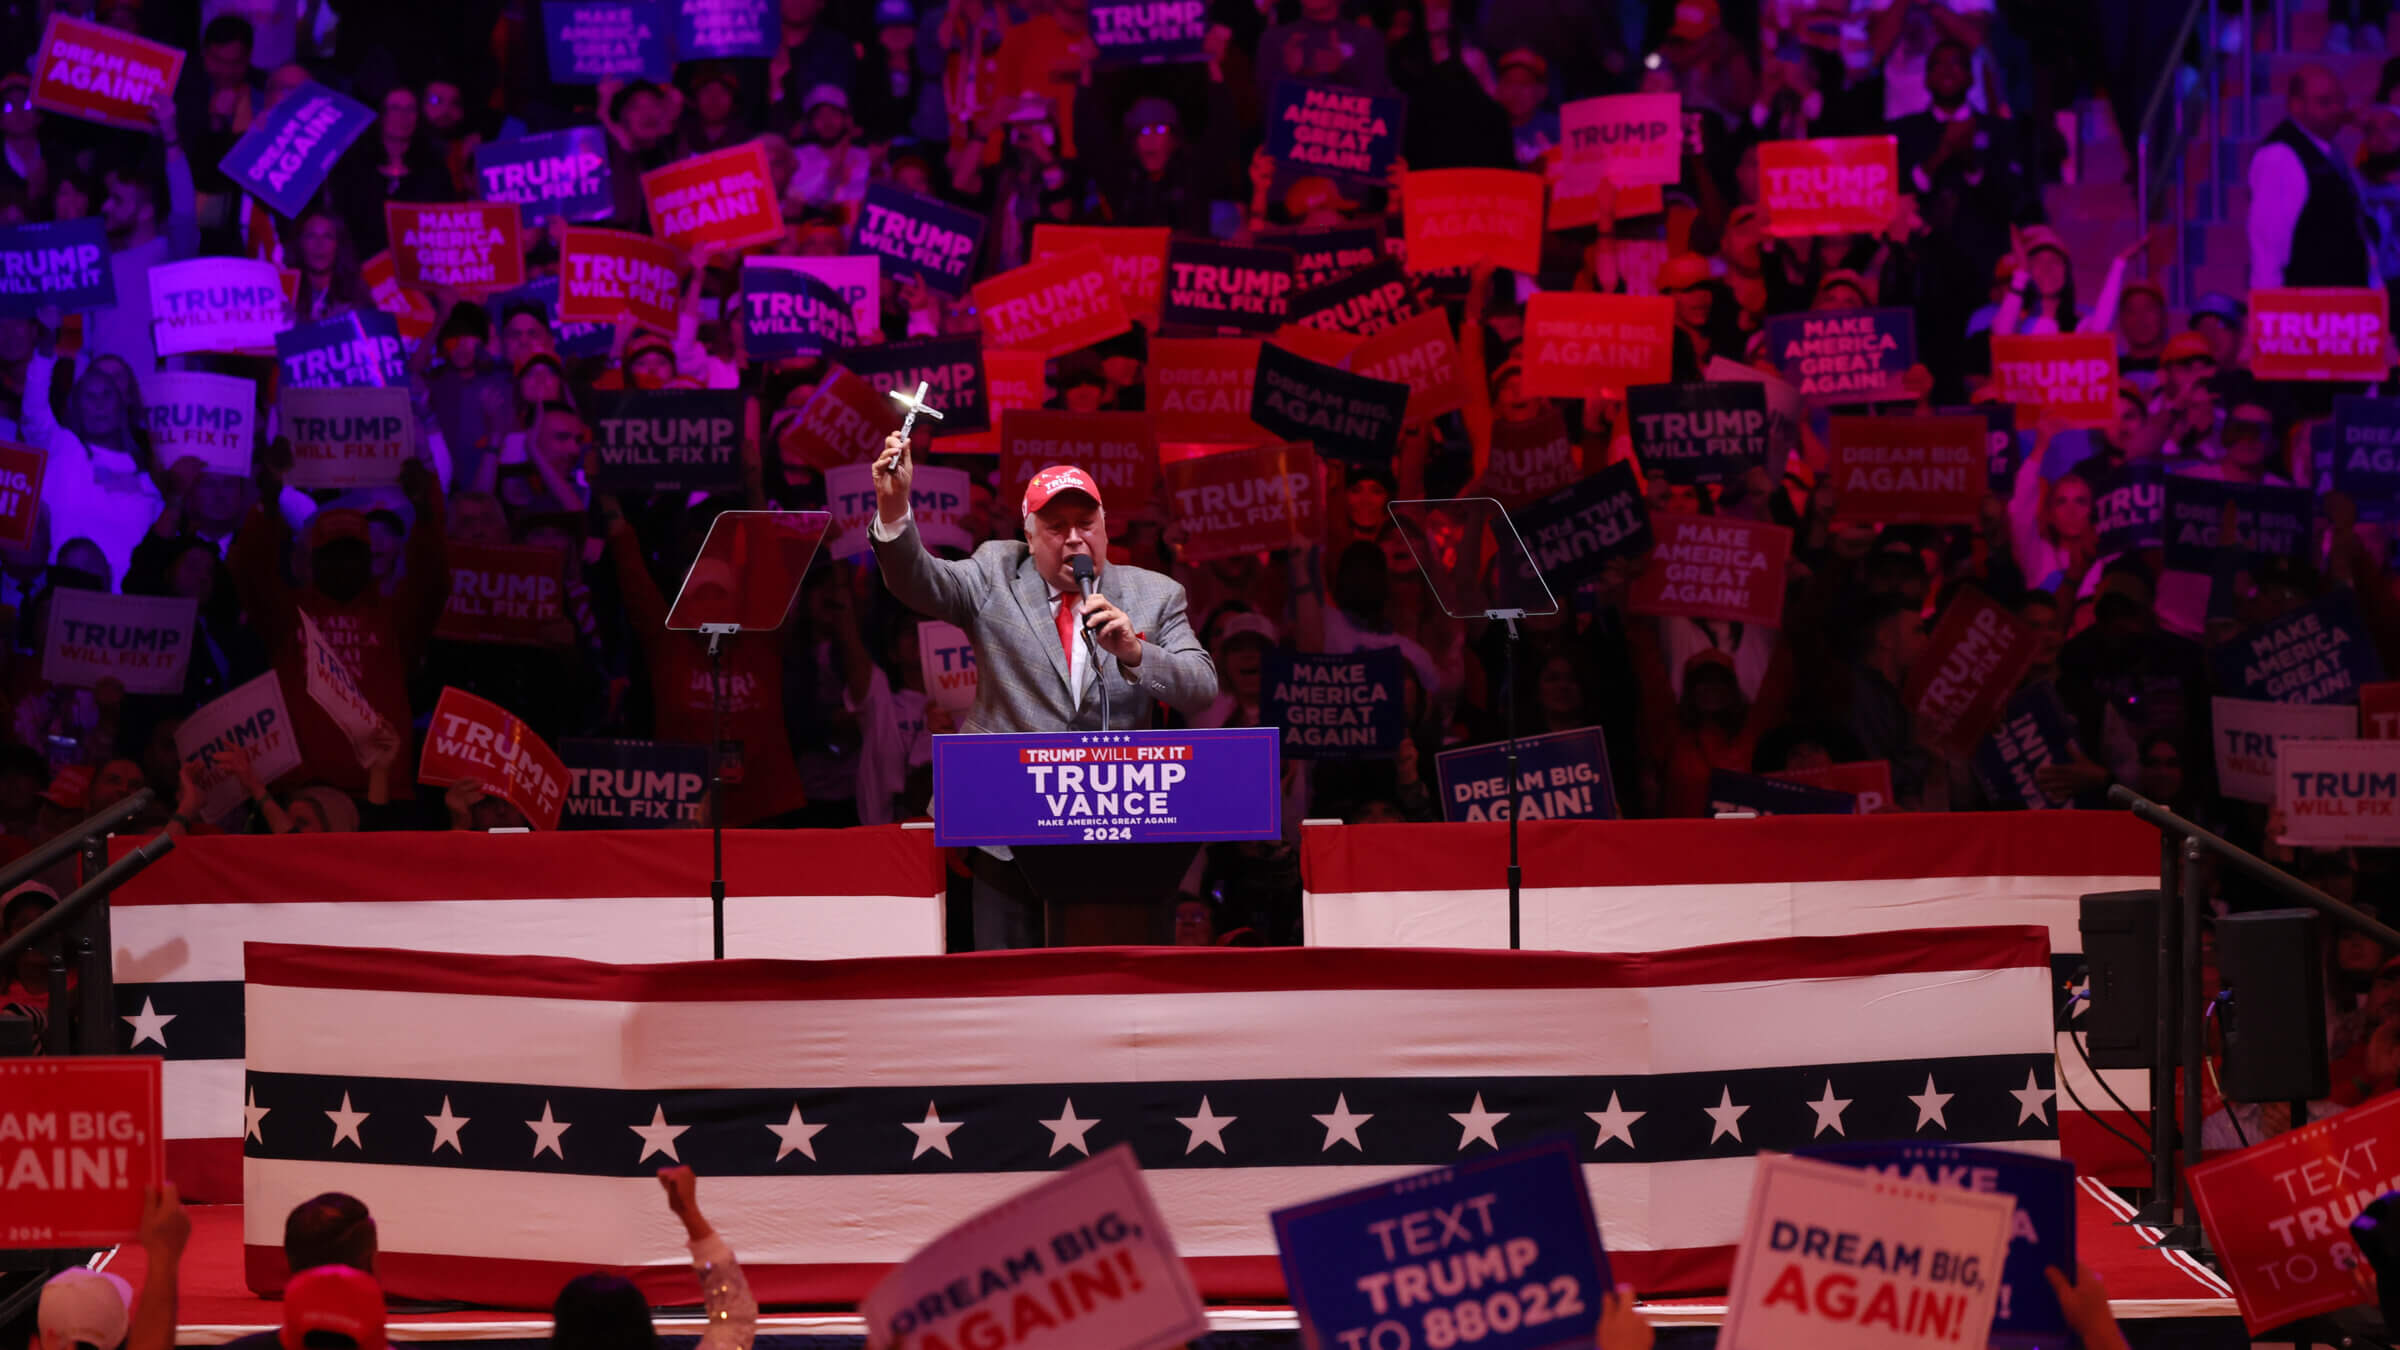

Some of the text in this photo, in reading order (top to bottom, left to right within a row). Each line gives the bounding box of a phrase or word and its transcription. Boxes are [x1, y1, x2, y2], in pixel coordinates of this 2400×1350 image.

[1092, 1, 1204, 31] TRUMP
[52, 39, 125, 70] DREAM
[47, 60, 155, 107] AGAIN!
[1304, 88, 1373, 116] MAKE
[1284, 104, 1388, 137] AMERICA
[268, 104, 344, 193] AGAIN!
[1293, 124, 1372, 153] GREAT
[1570, 121, 1667, 150] TRUMP
[247, 119, 298, 181] DREAM
[482, 154, 603, 192] TRUMP
[1766, 165, 1889, 194] TRUMP
[541, 180, 575, 200] FIX
[577, 176, 601, 195] IT
[416, 211, 484, 229] MAKE
[663, 191, 760, 237] AGAIN!
[403, 228, 505, 247] AMERICA
[865, 204, 973, 258] TRUMP
[415, 246, 494, 268] GREAT
[860, 229, 967, 277] WILL FIX IT
[41, 272, 79, 294] FIX
[81, 268, 101, 288] IT
[417, 264, 497, 286] AGAIN!
[567, 253, 679, 293] TRUMP
[1171, 262, 1292, 298] TRUMP
[163, 286, 276, 310] TRUMP
[568, 279, 658, 307] WILL FIX
[984, 272, 1106, 326] TRUMP
[1171, 290, 1288, 316] WILL FIX IT
[167, 309, 212, 328] WILL
[745, 292, 854, 334] TRUMP
[748, 318, 804, 336] WILL
[1803, 316, 1876, 336] MAKE
[2256, 311, 2382, 338] TRUMP
[997, 317, 1048, 345] WILL
[284, 335, 405, 381] TRUMP
[1538, 341, 1652, 368] AGAIN!
[1784, 332, 1897, 360] AMERICA
[2259, 336, 2381, 357] WILL FIX IT
[383, 357, 405, 379] IT
[1801, 353, 1882, 376] GREAT
[1999, 359, 2110, 386] TRUMP
[1265, 369, 1391, 423] DREAM BIG,
[1801, 371, 1887, 396] AGAIN!
[2047, 384, 2108, 403] FIX IT
[953, 389, 975, 409] IT
[144, 404, 244, 430] TRUMP
[1265, 391, 1380, 440] AGAIN!
[1636, 408, 1764, 443] TRUMP
[182, 430, 240, 449] FIX IT
[292, 416, 403, 444] TRUMP
[600, 418, 735, 446] TRUMP
[292, 441, 403, 460] WILL FIX IT
[600, 444, 735, 466] WILL FIX IT
[1013, 439, 1145, 463] DREAM BIG,
[1640, 435, 1766, 459] WILL FIX IT
[1841, 446, 1925, 466] DREAM
[1043, 476, 1084, 490] TRUMP
[1174, 472, 1310, 517] TRUMP
[1846, 467, 1966, 494] AGAIN!
[1180, 497, 1313, 536] WILL FIX IT
[1676, 521, 1753, 549] MAKE
[1652, 542, 1769, 572] AMERICA
[1664, 563, 1753, 588] GREAT
[1658, 582, 1752, 609] AGAIN!
[491, 599, 559, 621] FIX IT
[63, 619, 181, 652] TRUMP
[2251, 611, 2323, 660] MAKE
[60, 643, 179, 671] WILL FIX IT
[2243, 626, 2352, 687] AMERICA
[1292, 662, 1367, 685] MAKE
[2265, 649, 2342, 698] GREAT
[1273, 683, 1389, 705] AMERICA
[1285, 704, 1375, 726] GREAT
[264, 730, 281, 752] IT
[1283, 726, 1378, 747] AGAIN!
[443, 711, 560, 799] TRUMP
[1027, 747, 1186, 763] TRUMP WILL FIX IT
[436, 736, 554, 815] WILL FIX IT
[567, 767, 703, 801] TRUMP
[1026, 763, 1186, 794] TRUMP
[1549, 761, 1600, 788] BIG,
[2291, 772, 2398, 799] TRUM
[568, 798, 701, 821] WILL FIX IT
[1045, 792, 1169, 817] VANCE
[2292, 799, 2393, 817] WILL FIX
[1037, 816, 1178, 828] MAKE AMERICA GREAT AGAIN!
[1083, 827, 1133, 841] 2024
[69, 1111, 146, 1146] BIG,
[1862, 1163, 2000, 1194] MAKE
[2272, 1136, 2379, 1204] TEXT
[9, 1225, 54, 1241] 2024
[1366, 1192, 1498, 1262] TEXT
[1769, 1219, 1986, 1294] DREAM BIG,
[889, 1210, 1145, 1338] DREAM BIG,
[1356, 1236, 1540, 1316] TRUMP
[2256, 1253, 2319, 1292] TO
[1422, 1274, 1588, 1350] 88022
[1761, 1261, 1971, 1343] AGAIN!
